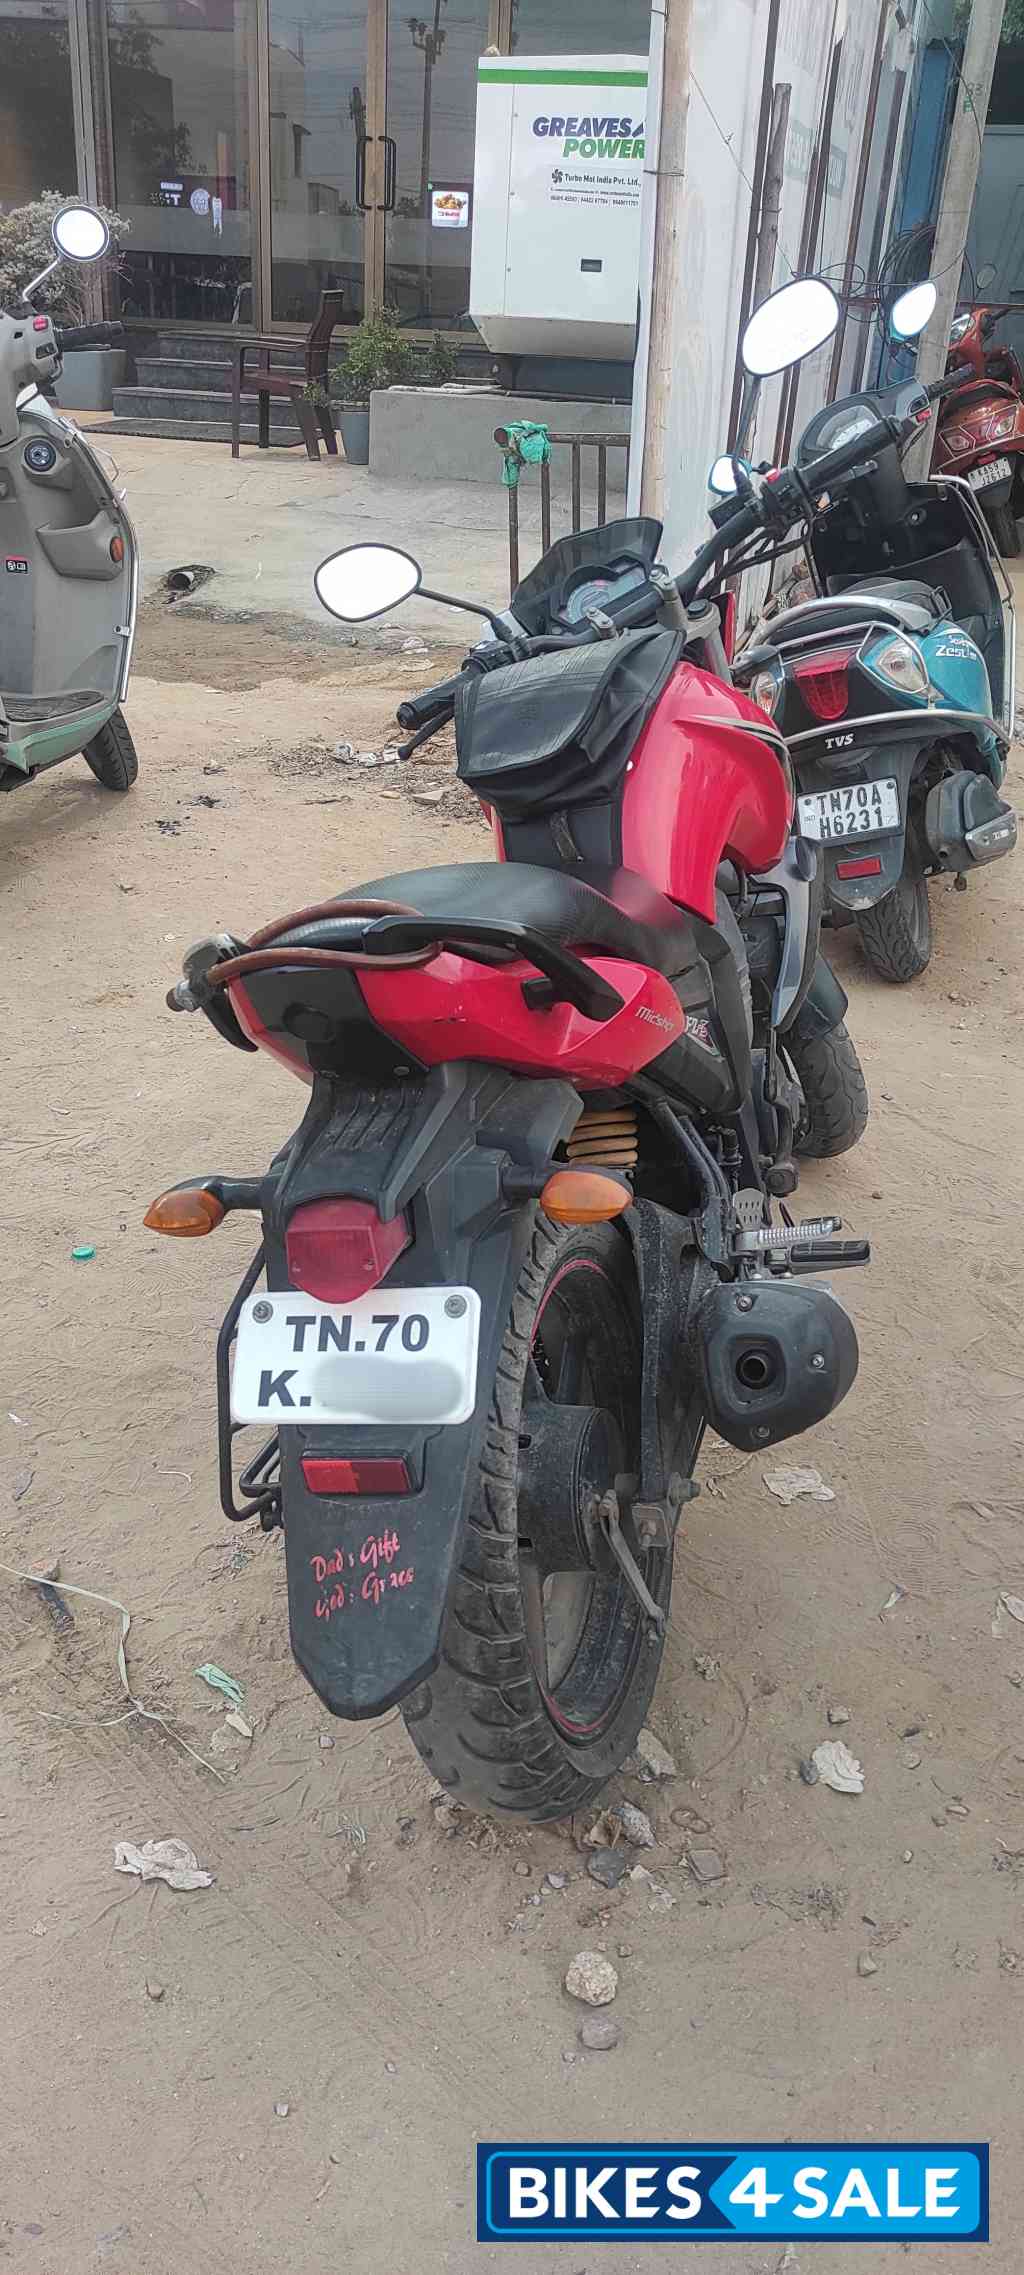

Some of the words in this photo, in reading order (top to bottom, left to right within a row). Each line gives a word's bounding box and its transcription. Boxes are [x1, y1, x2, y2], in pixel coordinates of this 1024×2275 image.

[533, 116, 633, 138] GREAVES
[562, 138, 645, 159] POWER
[597, 175, 612, 184] India
[613, 176, 626, 185] Pvt.
[825, 733, 854, 749] TVS
[816, 784, 882, 815] TN70A
[819, 807, 883, 838] H6231
[286, 1313, 430, 1353] TN.70
[360, 1529, 400, 1568] Gift
